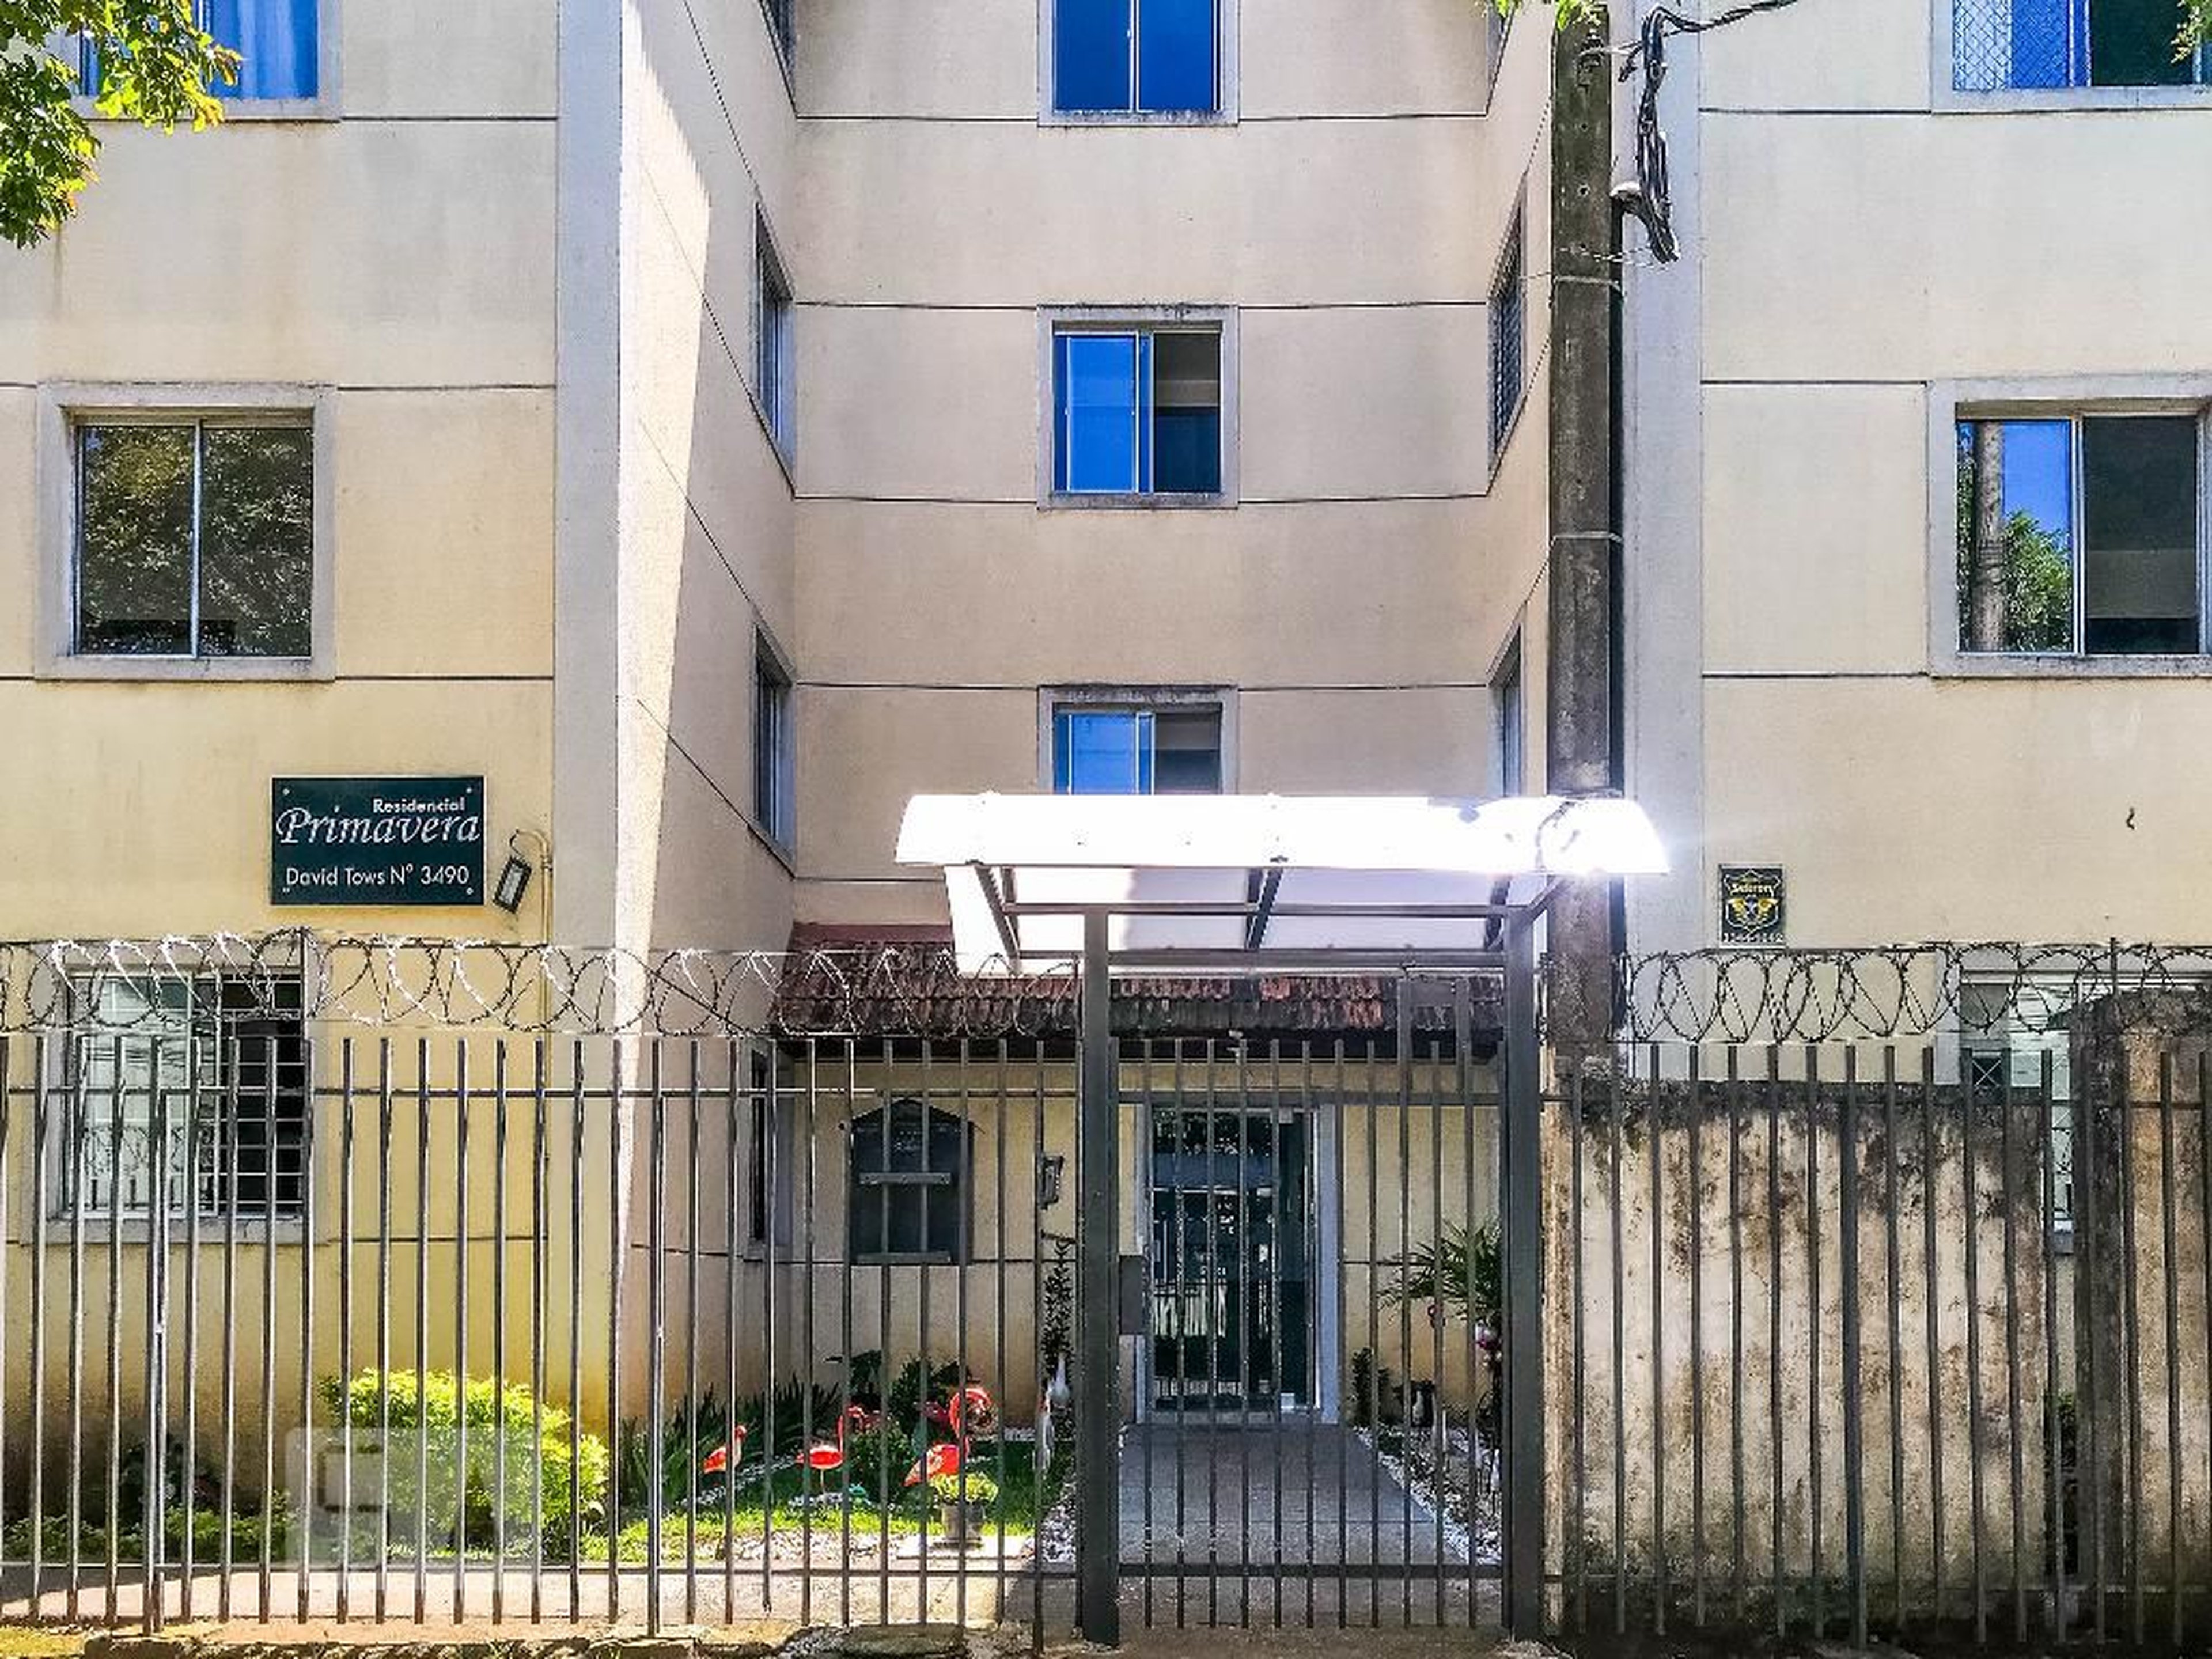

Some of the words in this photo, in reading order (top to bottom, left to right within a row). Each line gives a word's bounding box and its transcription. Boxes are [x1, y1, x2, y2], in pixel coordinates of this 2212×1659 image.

[373, 797, 465, 813] Residencial
[276, 806, 480, 843] Primavera
[287, 867, 338, 885] David
[345, 867, 385, 885] Tows
[421, 865, 469, 885] 3490
